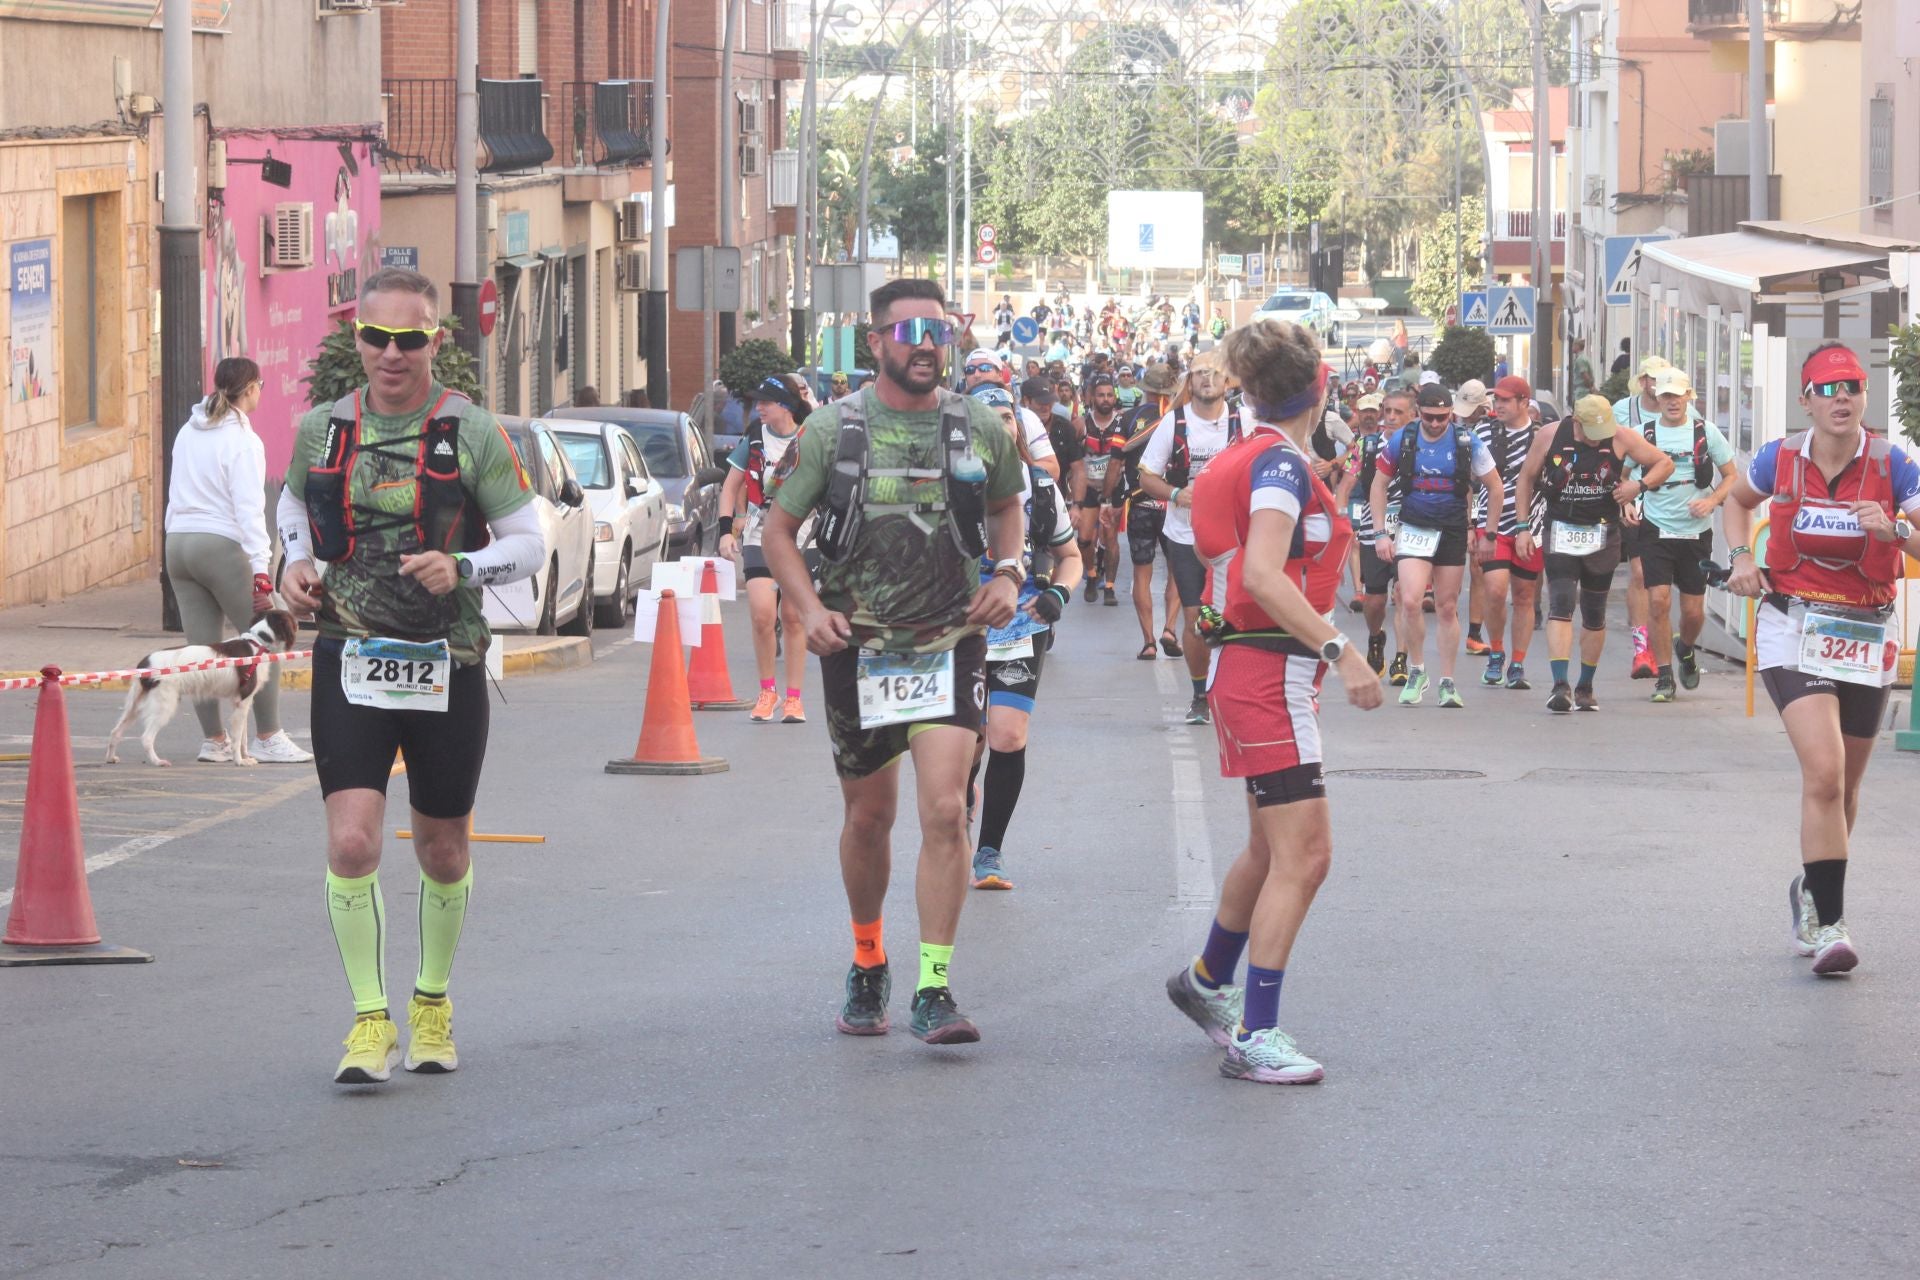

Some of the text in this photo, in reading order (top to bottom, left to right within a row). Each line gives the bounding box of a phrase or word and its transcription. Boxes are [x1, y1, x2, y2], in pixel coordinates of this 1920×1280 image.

[388, 248, 412, 256] CALLE
[391, 255, 410, 265] JUAN
[1402, 532, 1431, 548] 3791
[1567, 531, 1595, 544] 3683
[1820, 636, 1870, 665] 3241
[366, 658, 434, 685] 2812
[878, 673, 939, 702] 1624
